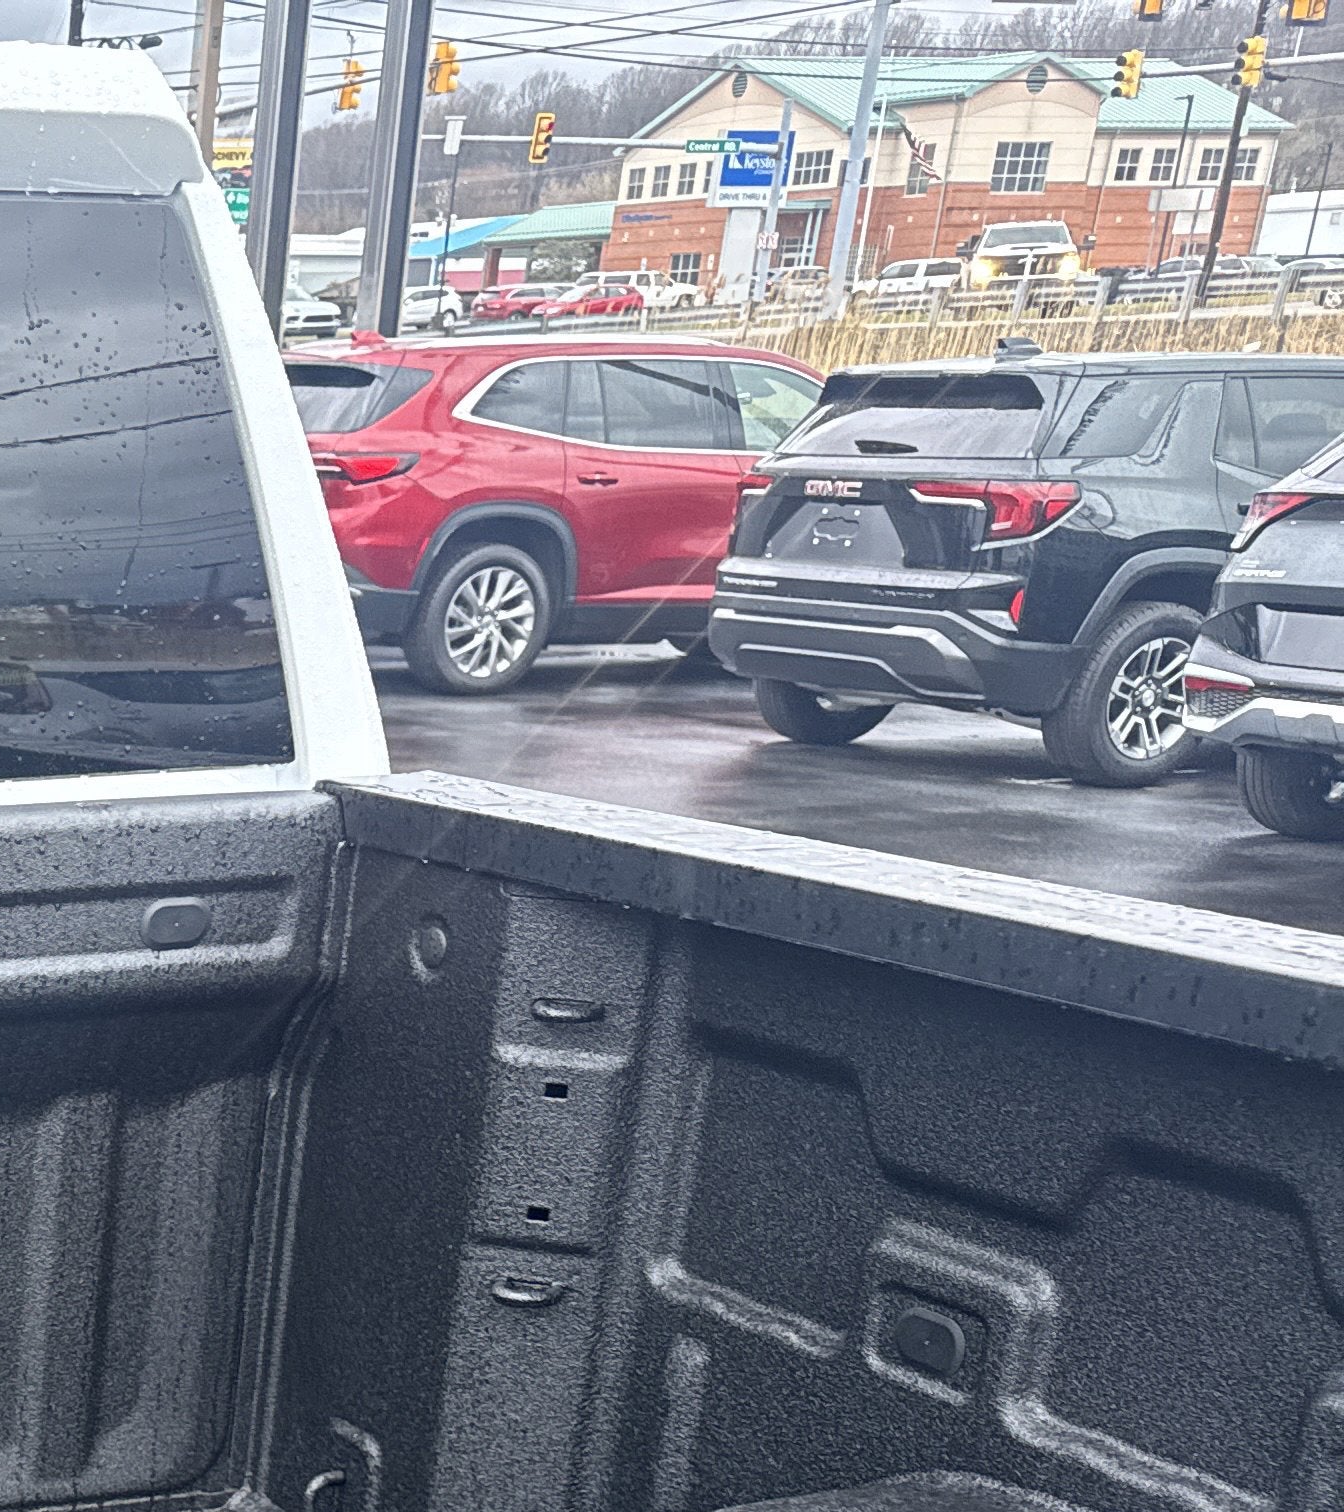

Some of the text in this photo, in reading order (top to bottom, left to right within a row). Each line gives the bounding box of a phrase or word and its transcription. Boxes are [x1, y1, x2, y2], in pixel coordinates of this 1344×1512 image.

[688, 141, 720, 152] Central
[719, 193, 740, 201] DRIVE
[741, 193, 761, 201] THRU
[804, 479, 863, 498] GMC
